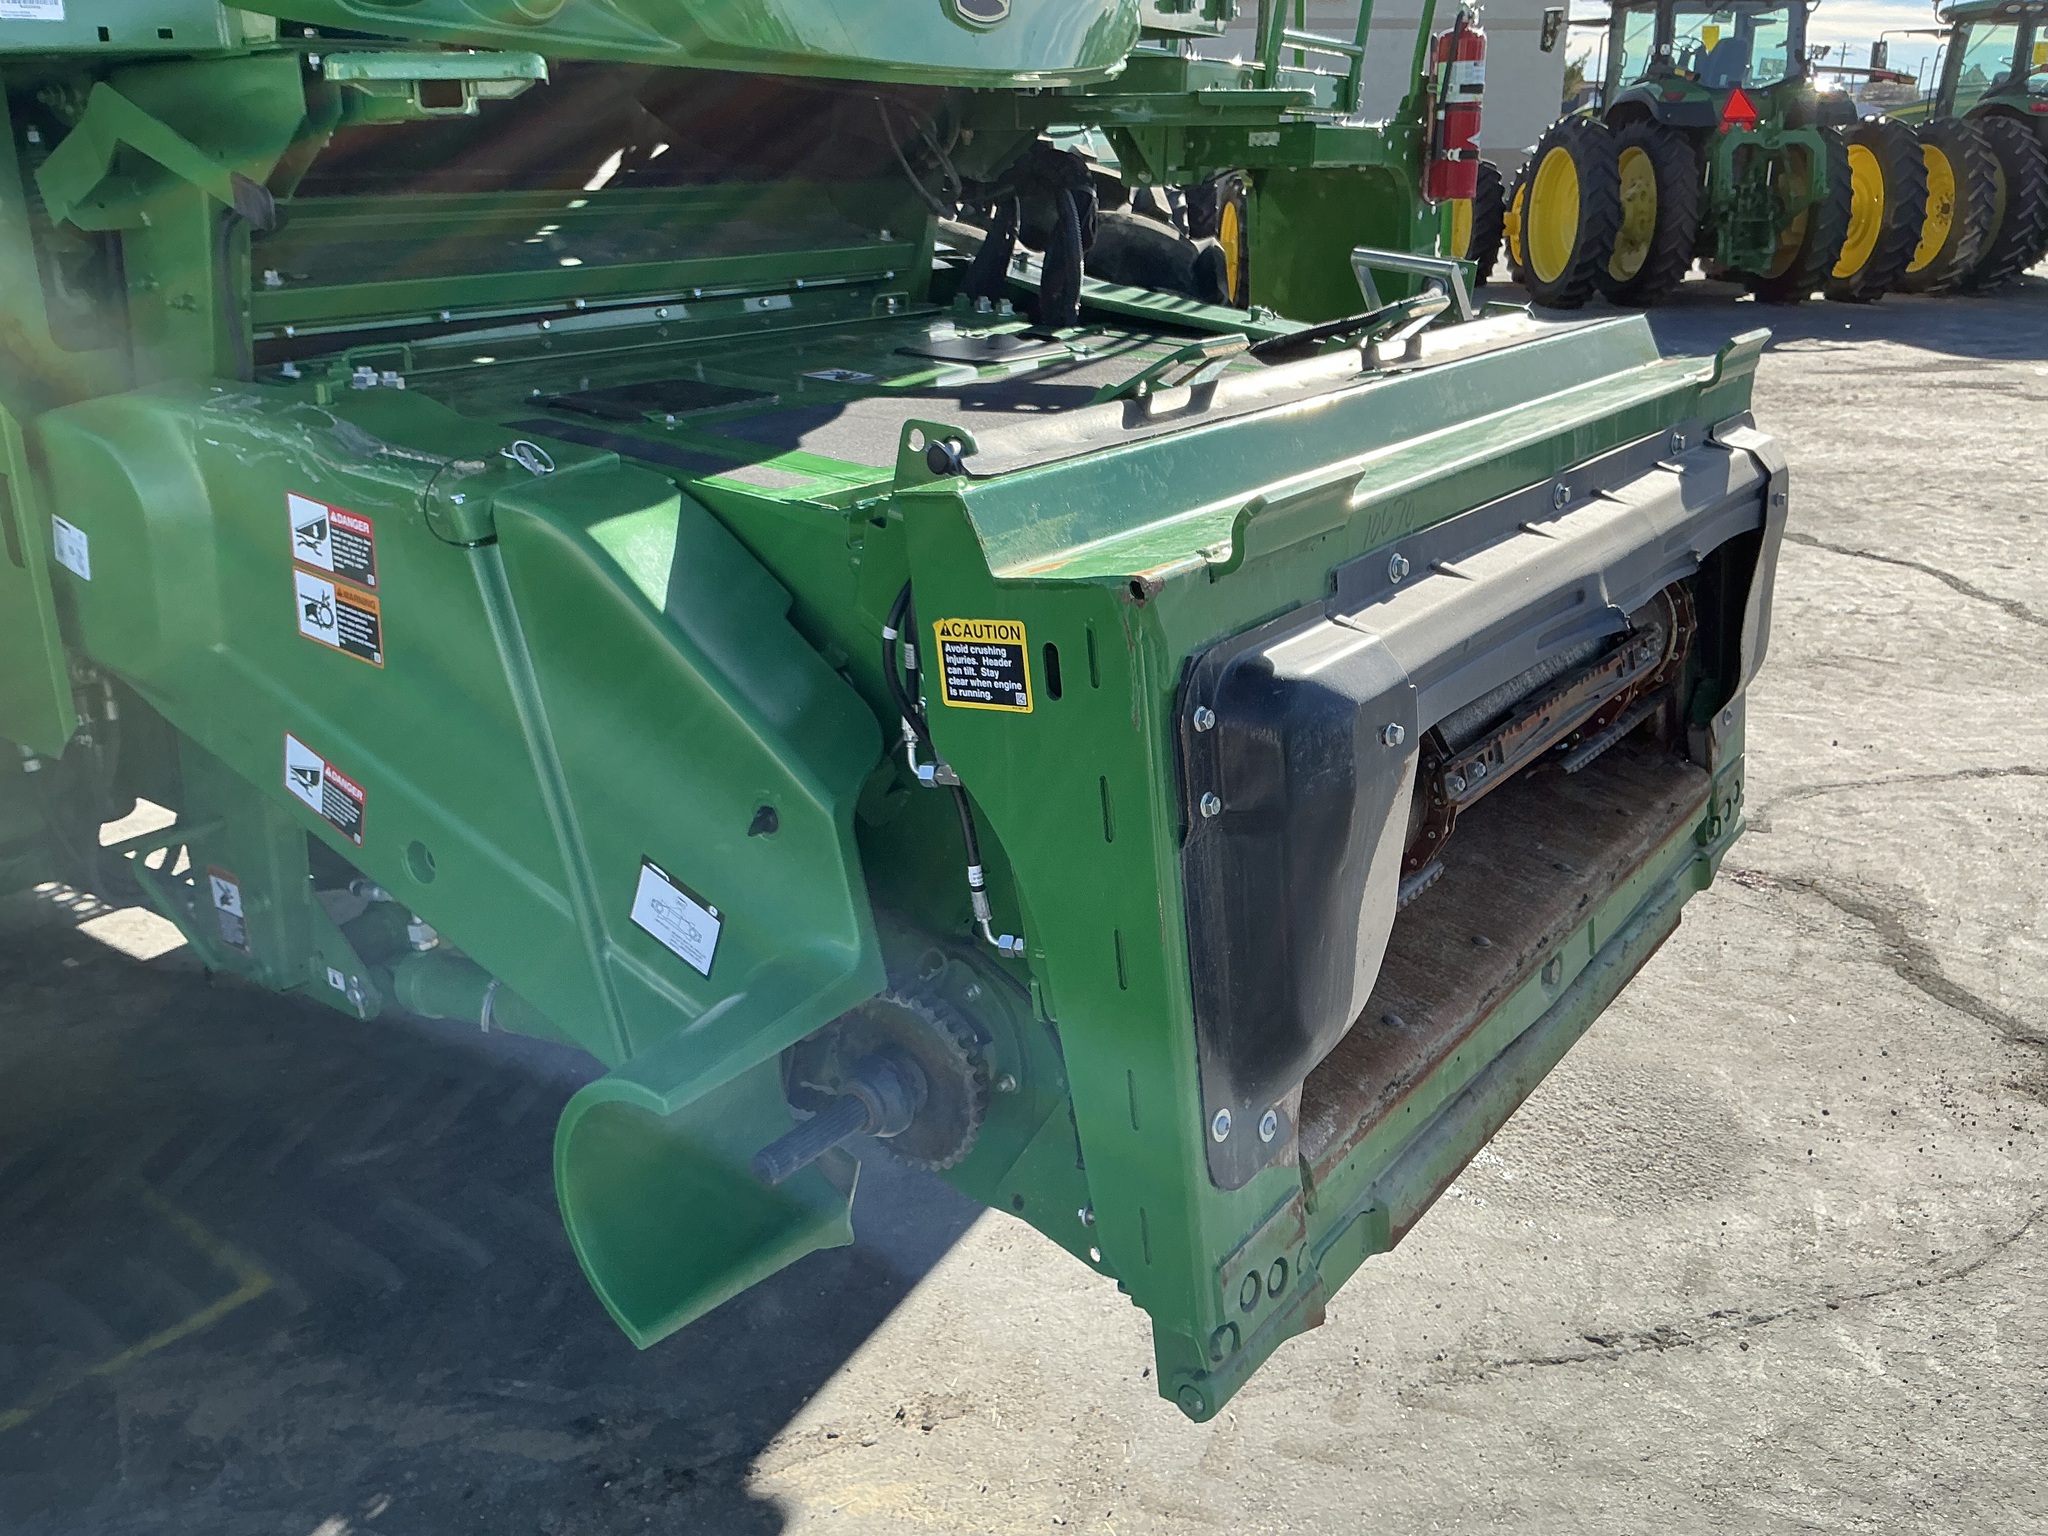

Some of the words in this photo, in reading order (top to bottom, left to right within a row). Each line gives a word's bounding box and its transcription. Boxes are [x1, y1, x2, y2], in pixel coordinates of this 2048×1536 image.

[336, 513, 370, 534] DANGER
[343, 590, 376, 610] WARNING
[952, 623, 1021, 640] CAUTION
[944, 643, 968, 654] Avoid
[969, 645, 1007, 658] crushing
[945, 654, 979, 666] injuries.
[981, 656, 1012, 667] Header
[947, 667, 962, 675] can
[963, 666, 978, 676] tilt.
[980, 667, 1000, 680] Stay
[948, 676, 968, 686] clear
[969, 678, 993, 688] when
[993, 680, 1023, 691] engine
[949, 686, 958, 696] is
[958, 688, 994, 701] running.
[331, 769, 363, 801] DANGER
